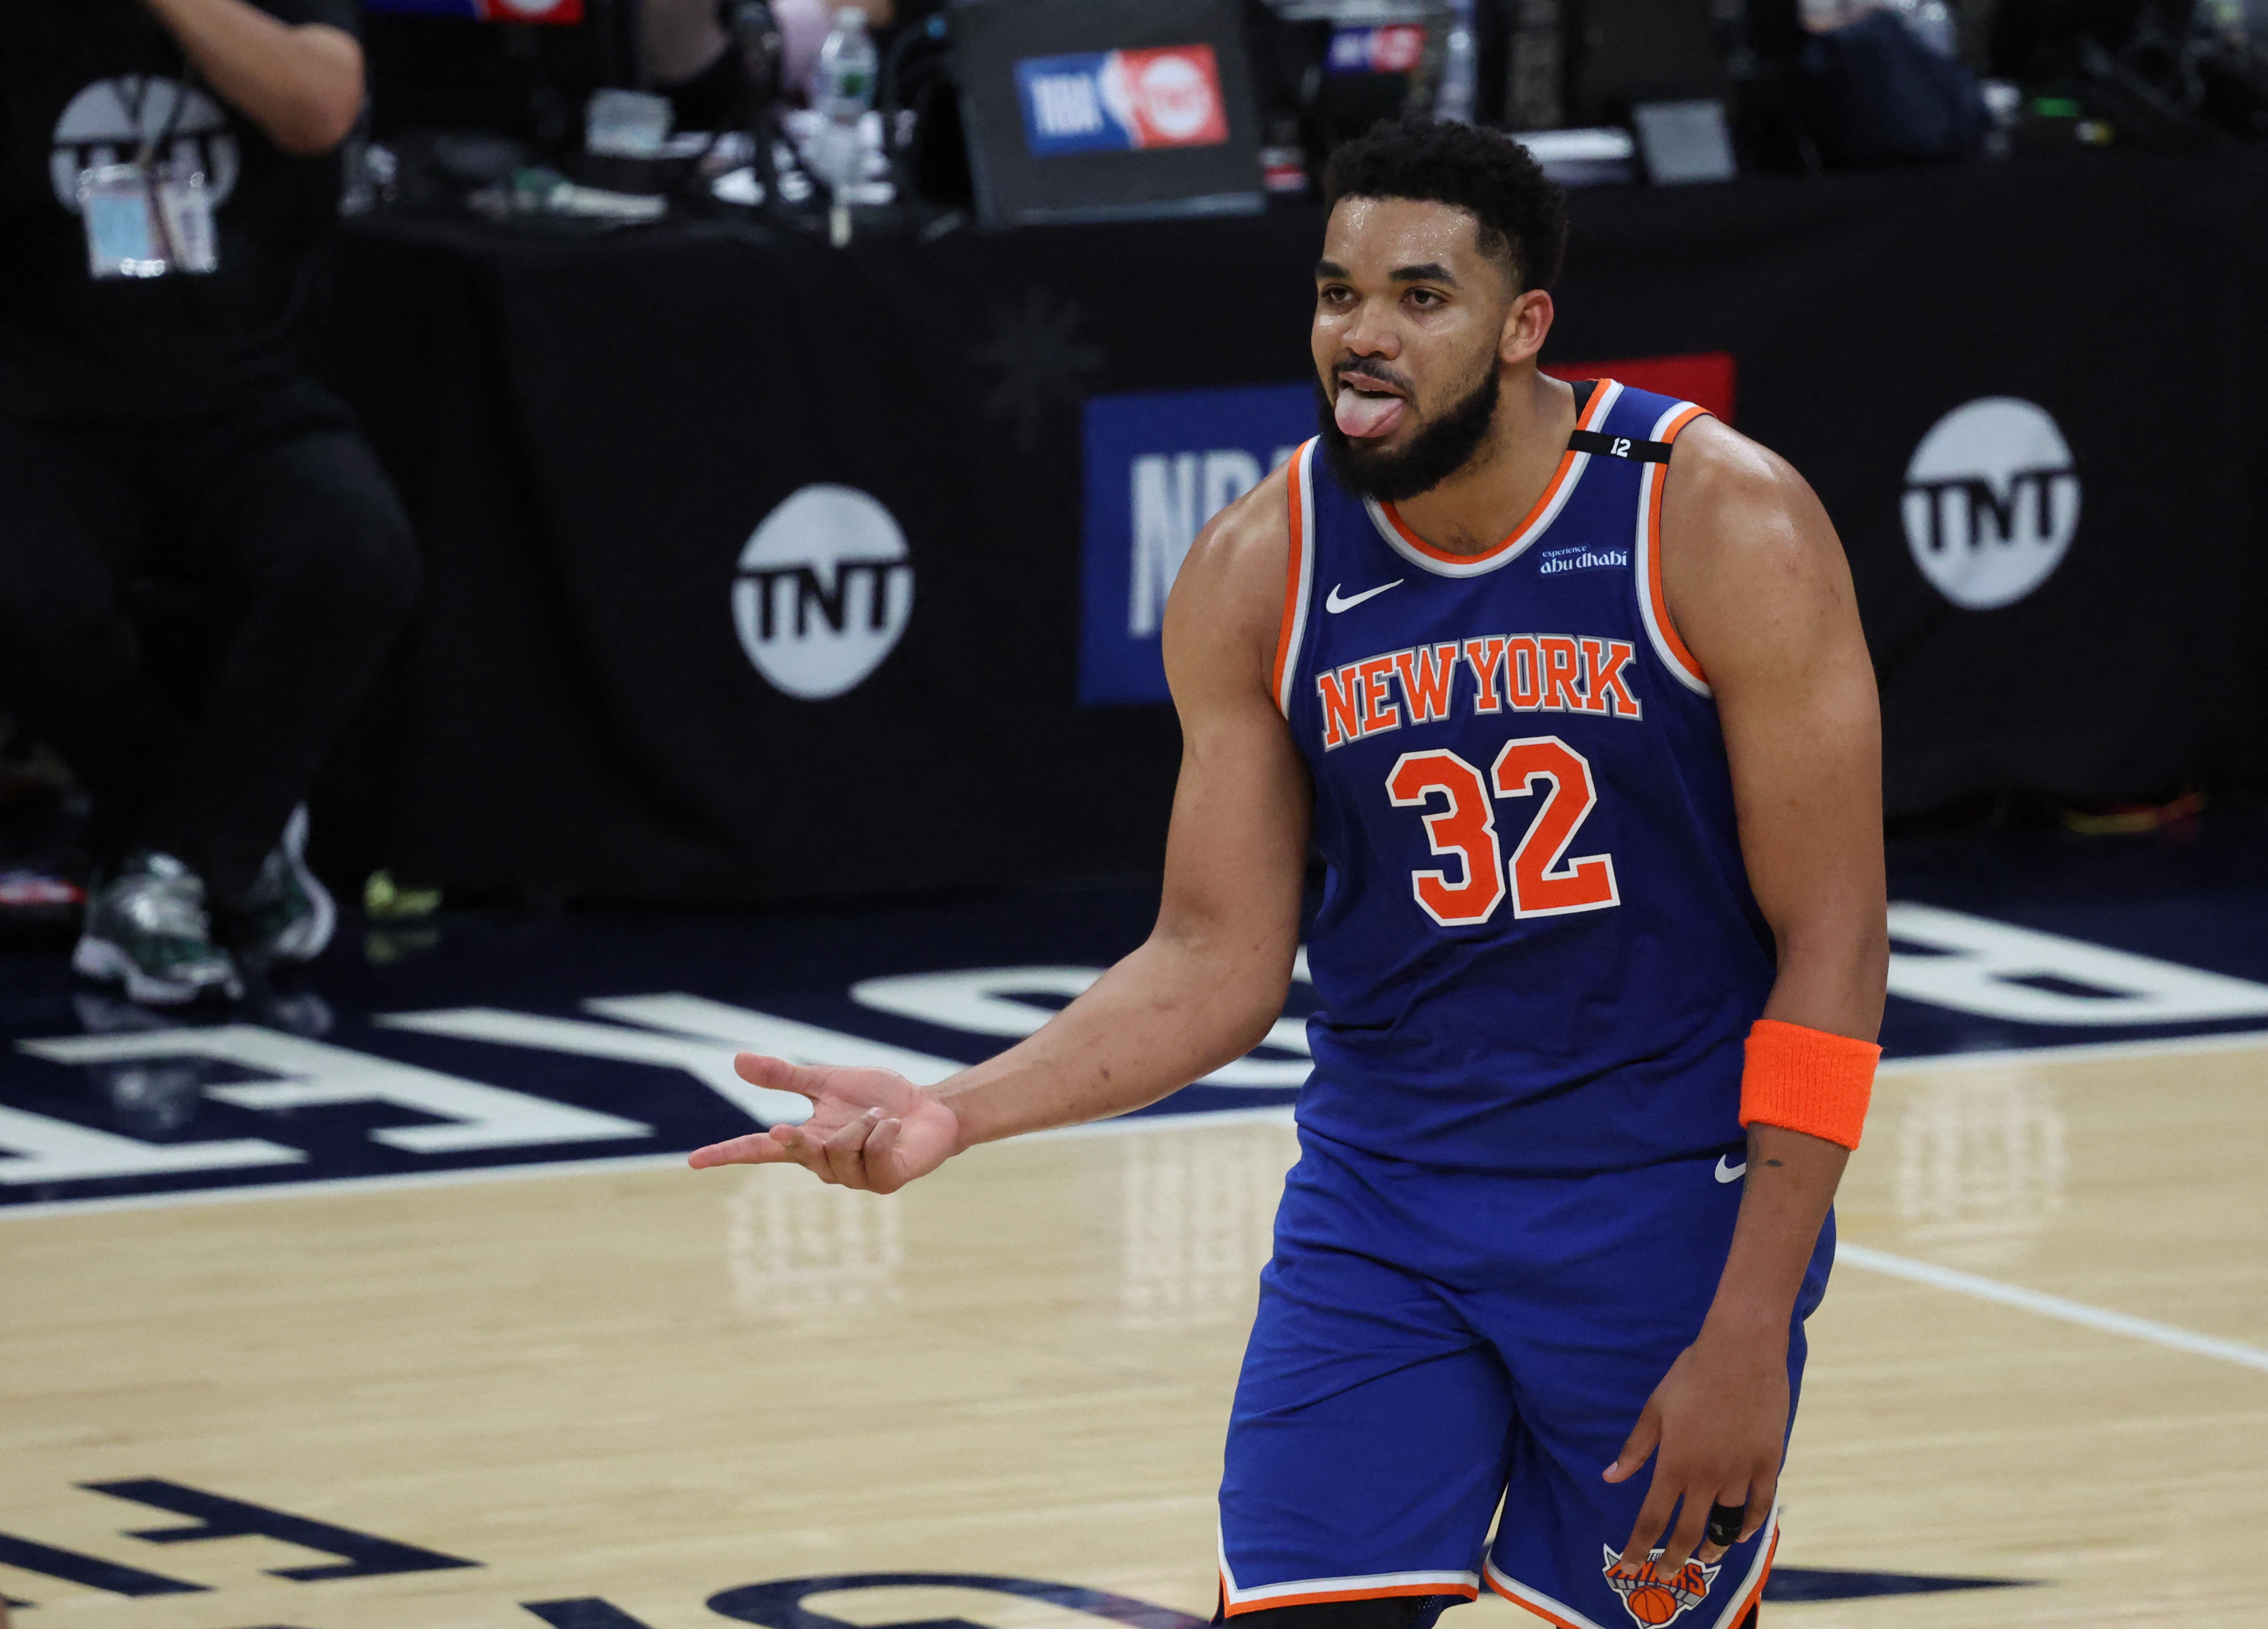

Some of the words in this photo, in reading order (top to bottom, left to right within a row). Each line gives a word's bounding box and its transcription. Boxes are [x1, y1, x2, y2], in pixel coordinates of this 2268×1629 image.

[1610, 437, 1631, 458] 12
[1540, 557, 1573, 574] abu
[1575, 550, 1628, 568] dhabi
[1542, 545, 1587, 558] experience
[1315, 640, 1461, 752] NEW
[1463, 632, 1643, 721] YORK
[1385, 735, 1621, 927] 32
